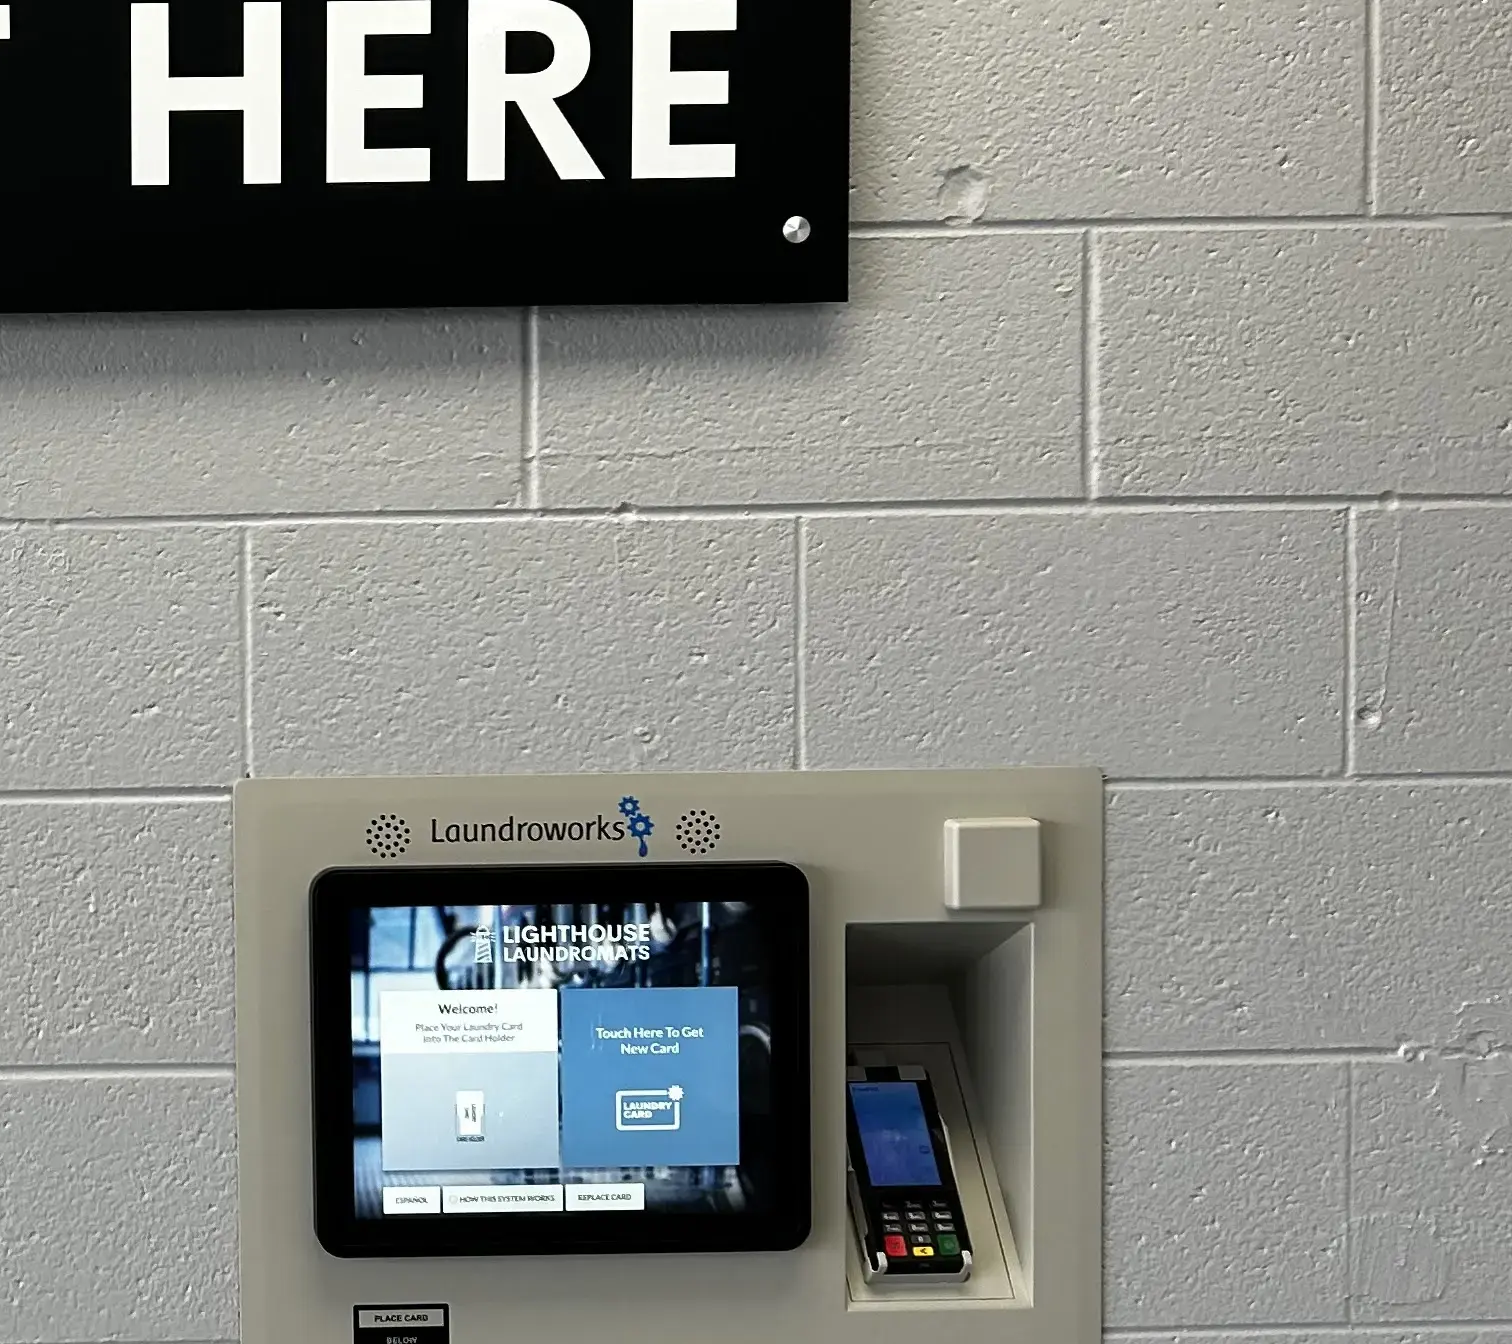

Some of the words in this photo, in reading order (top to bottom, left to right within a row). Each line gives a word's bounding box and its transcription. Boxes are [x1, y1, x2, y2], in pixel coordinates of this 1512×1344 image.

[431, 815, 625, 843] Laundroworks
[503, 924, 650, 944] LIGHTHOUSE
[503, 945, 650, 963] LAUNDROMATS
[438, 1003, 498, 1015] Welcome!
[415, 1022, 439, 1032] Place
[441, 1022, 461, 1032] Your
[463, 1022, 499, 1033] Laundry
[501, 1022, 523, 1031] Card
[596, 1027, 631, 1039] Touch
[634, 1027, 663, 1039] Here
[665, 1027, 679, 1038] To
[681, 1027, 704, 1038] Get
[443, 1034, 459, 1043] The
[461, 1034, 483, 1043] Card
[485, 1034, 515, 1043] Holder
[621, 1043, 648, 1055] New
[650, 1043, 679, 1054] Card
[623, 1101, 672, 1111] LAUNDRY
[623, 1110, 653, 1119] CARD
[459, 1196, 479, 1204] HOW
[481, 1195, 496, 1203] THIS
[498, 1195, 526, 1203] SYSTEM
[611, 1193, 632, 1202] CARD
[387, 1337, 418, 1344] BELOW
